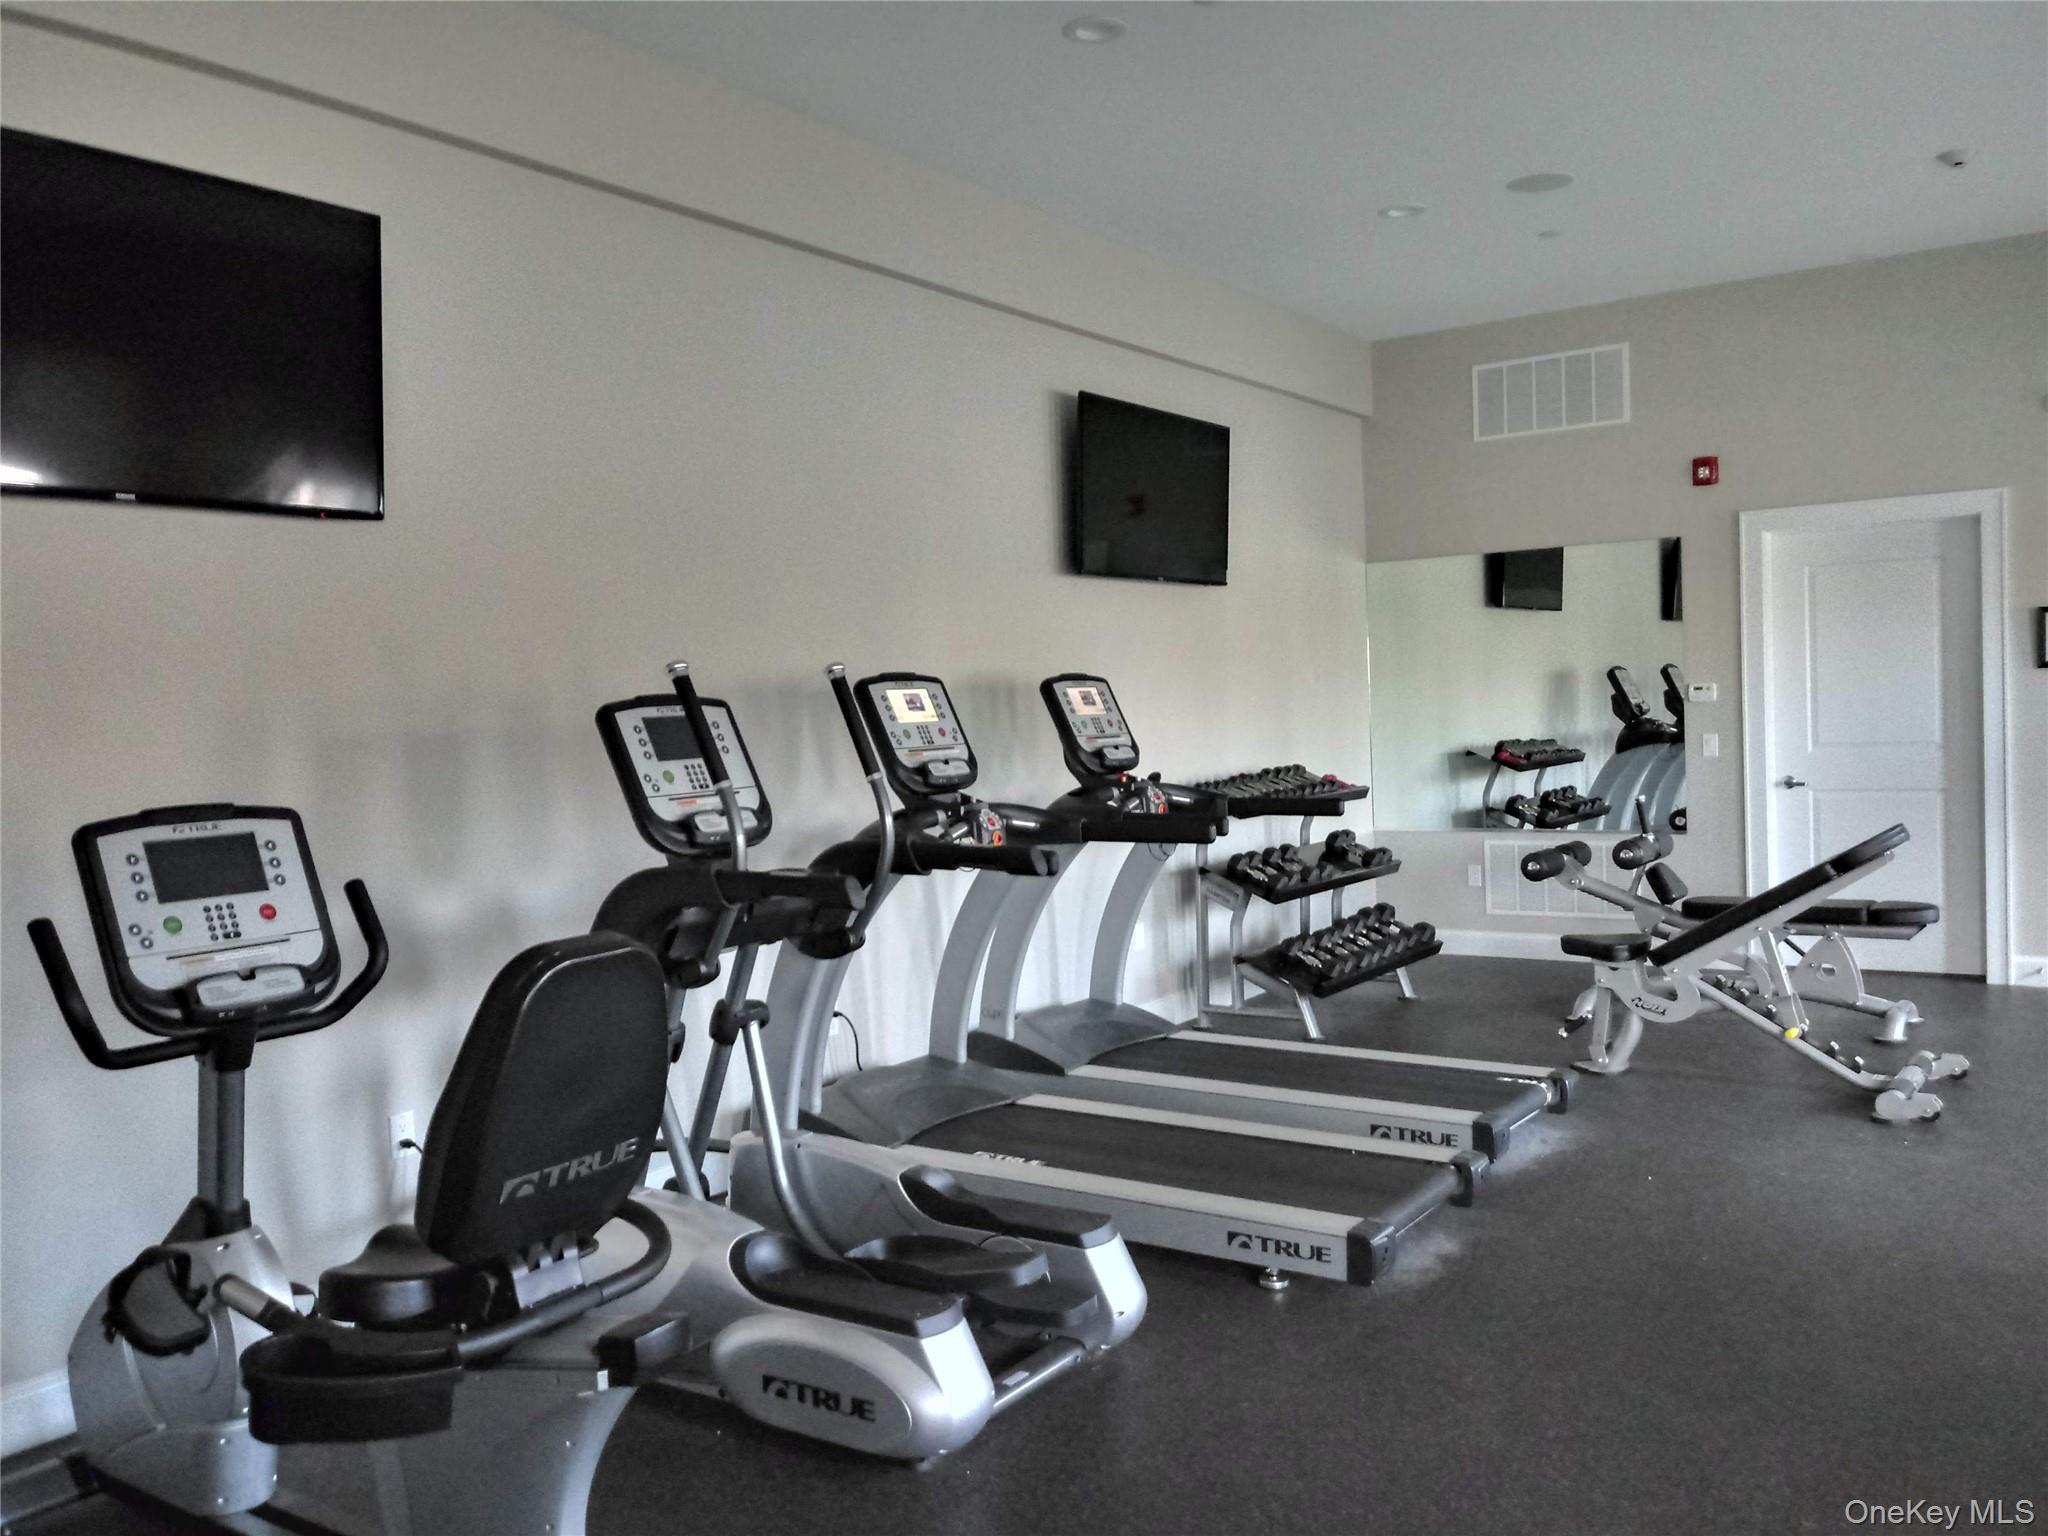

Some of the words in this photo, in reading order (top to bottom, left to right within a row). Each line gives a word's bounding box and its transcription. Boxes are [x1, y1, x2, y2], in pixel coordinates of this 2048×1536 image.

[1395, 1126, 1459, 1148] TRUE
[543, 1137, 639, 1187] TRUE
[1255, 1236, 1332, 1263] TRUE
[797, 1385, 876, 1422] TRUE
